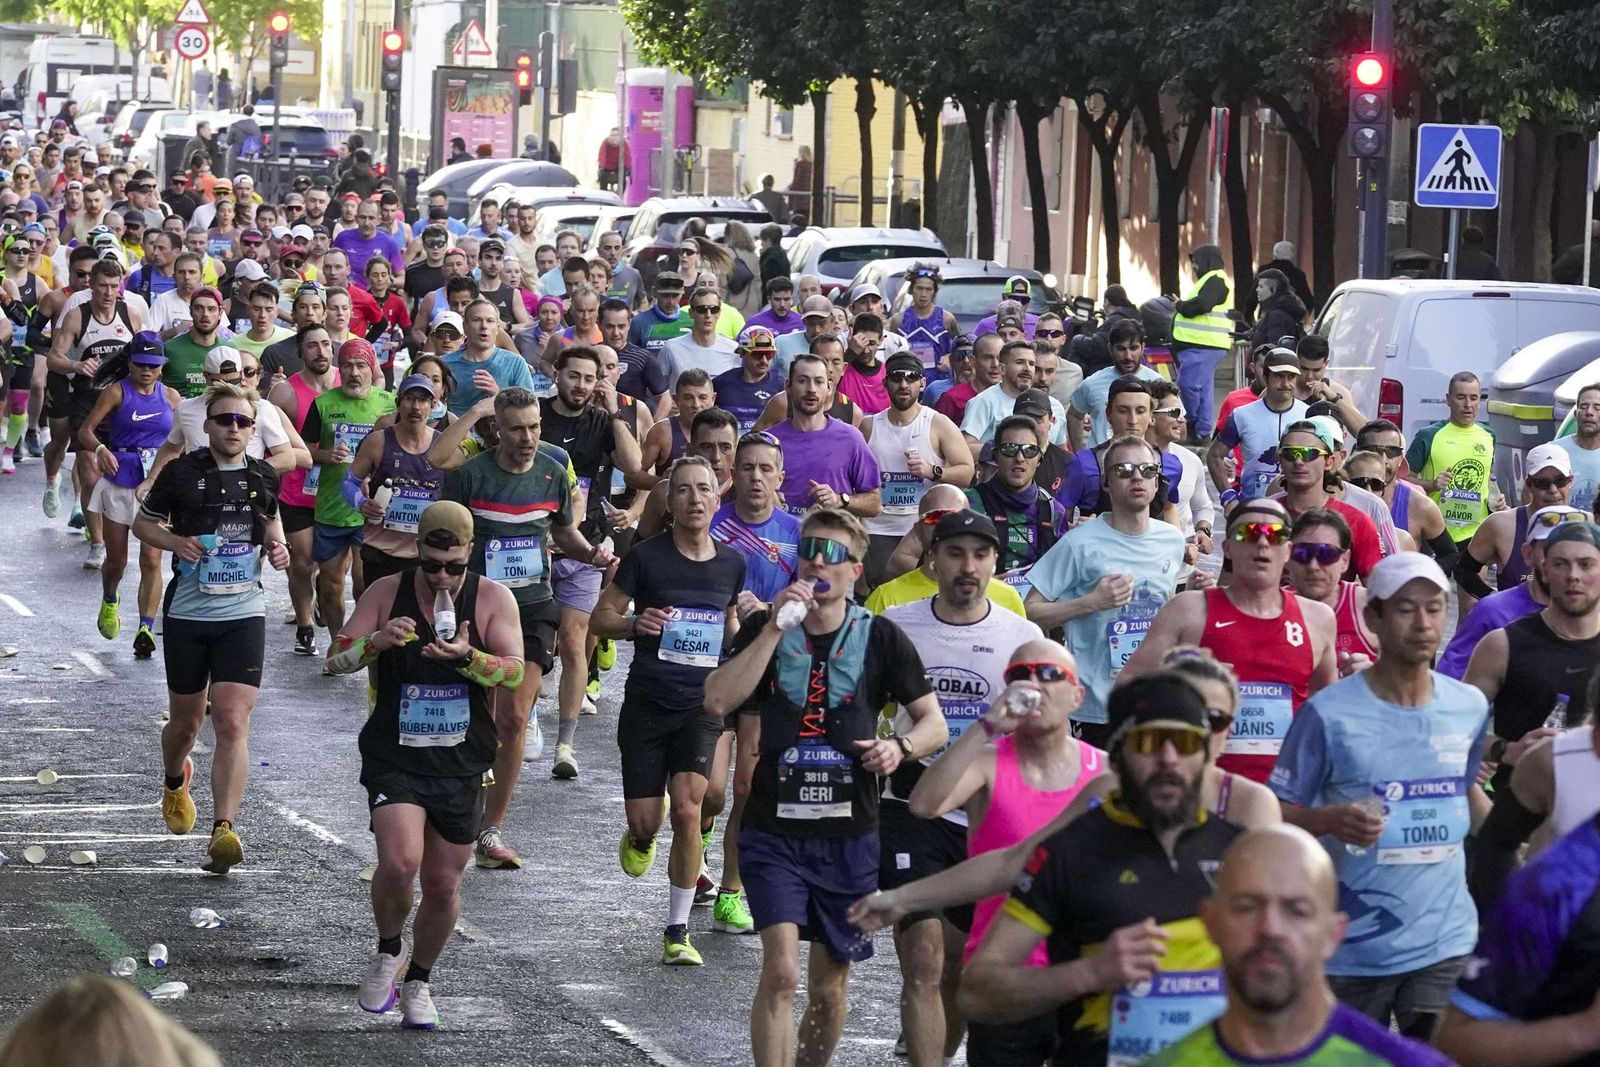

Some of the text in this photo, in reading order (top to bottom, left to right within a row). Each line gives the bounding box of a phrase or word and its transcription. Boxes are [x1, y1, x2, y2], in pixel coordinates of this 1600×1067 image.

[182, 36, 203, 48] 30
[403, 490, 431, 499] ZURICH
[888, 496, 915, 505] JUANK
[388, 510, 420, 523] ANTON
[222, 544, 249, 555] ZURICH
[504, 539, 534, 549] ZURICH
[207, 571, 249, 583] MICHIEL
[504, 566, 527, 577] TONI
[685, 611, 718, 622] ZURICH
[685, 628, 703, 638] 9421
[673, 637, 710, 653] CÉSAR
[424, 688, 461, 698] ZURICH
[1240, 685, 1283, 696] ZURICH
[423, 707, 446, 717] 7418
[400, 719, 468, 733] RÚBEN ALVES
[803, 750, 845, 761] ZURICH
[803, 771, 829, 783] 3818
[799, 786, 833, 802] GERI
[1408, 782, 1457, 796] ZURICH
[1400, 824, 1450, 844] TOMO
[1158, 976, 1221, 994] ZURICH
